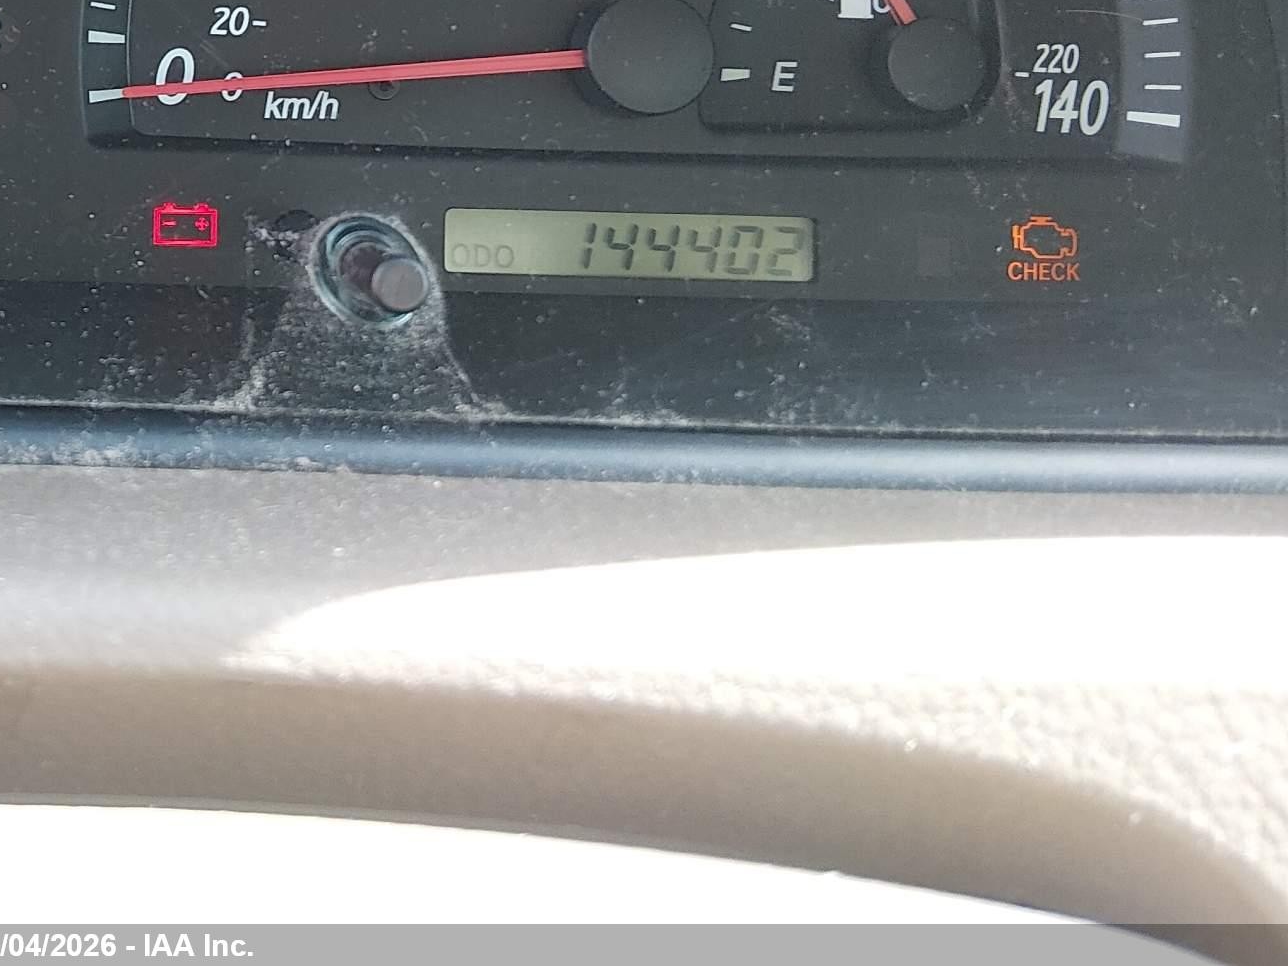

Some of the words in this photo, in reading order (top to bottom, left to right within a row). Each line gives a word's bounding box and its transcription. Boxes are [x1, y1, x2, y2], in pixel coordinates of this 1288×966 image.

[210, 6, 249, 36] 20
[1032, 44, 1079, 73] 220
[155, 48, 195, 105] 0
[772, 62, 798, 92] E
[264, 90, 339, 120] km/h
[1032, 80, 1109, 135] 140
[450, 243, 515, 269] ODO
[581, 222, 803, 277] 144402
[1007, 262, 1081, 282] CHECK
